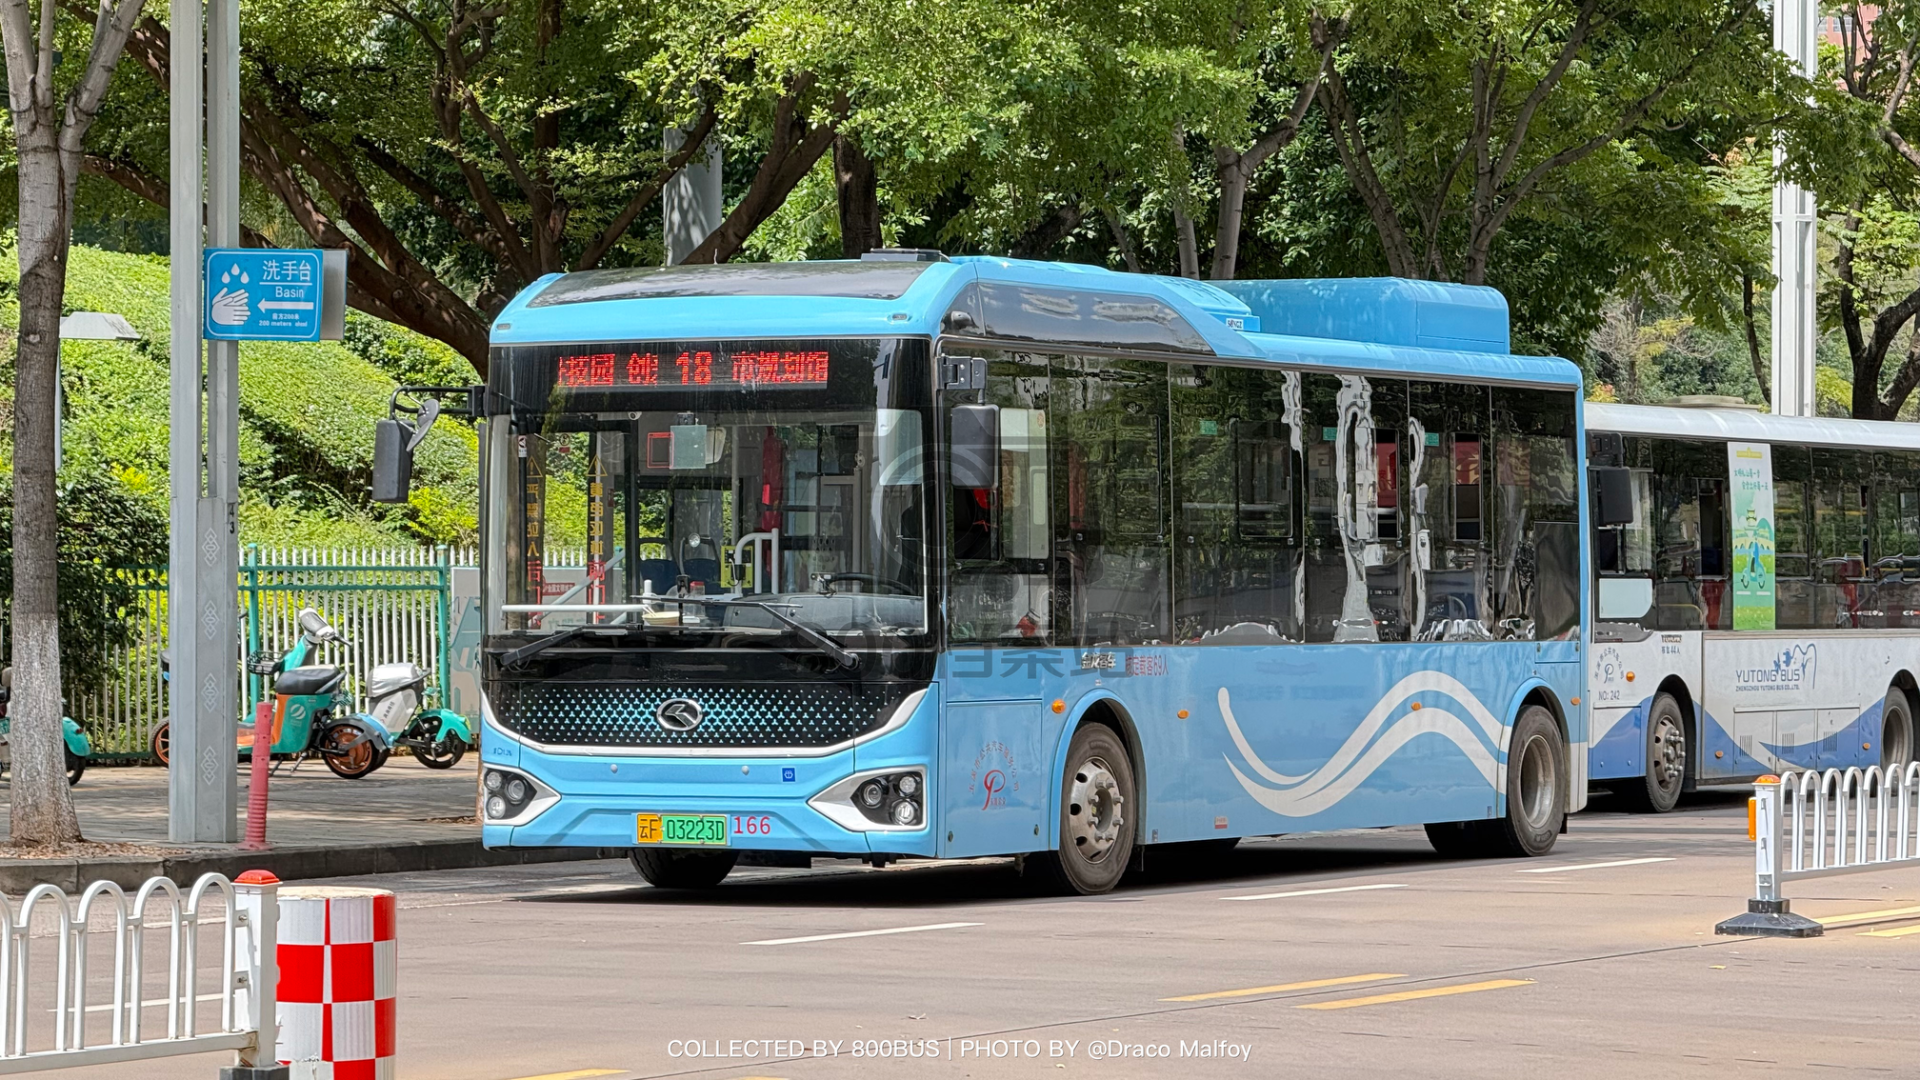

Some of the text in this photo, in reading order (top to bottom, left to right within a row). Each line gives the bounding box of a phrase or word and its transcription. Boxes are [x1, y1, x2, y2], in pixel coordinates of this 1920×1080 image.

[262, 259, 311, 281] 洗手台
[275, 286, 304, 298] Basin
[676, 352, 712, 385] 18
[1736, 668, 1800, 683] YUTONG BUS
[733, 815, 771, 835] 166
